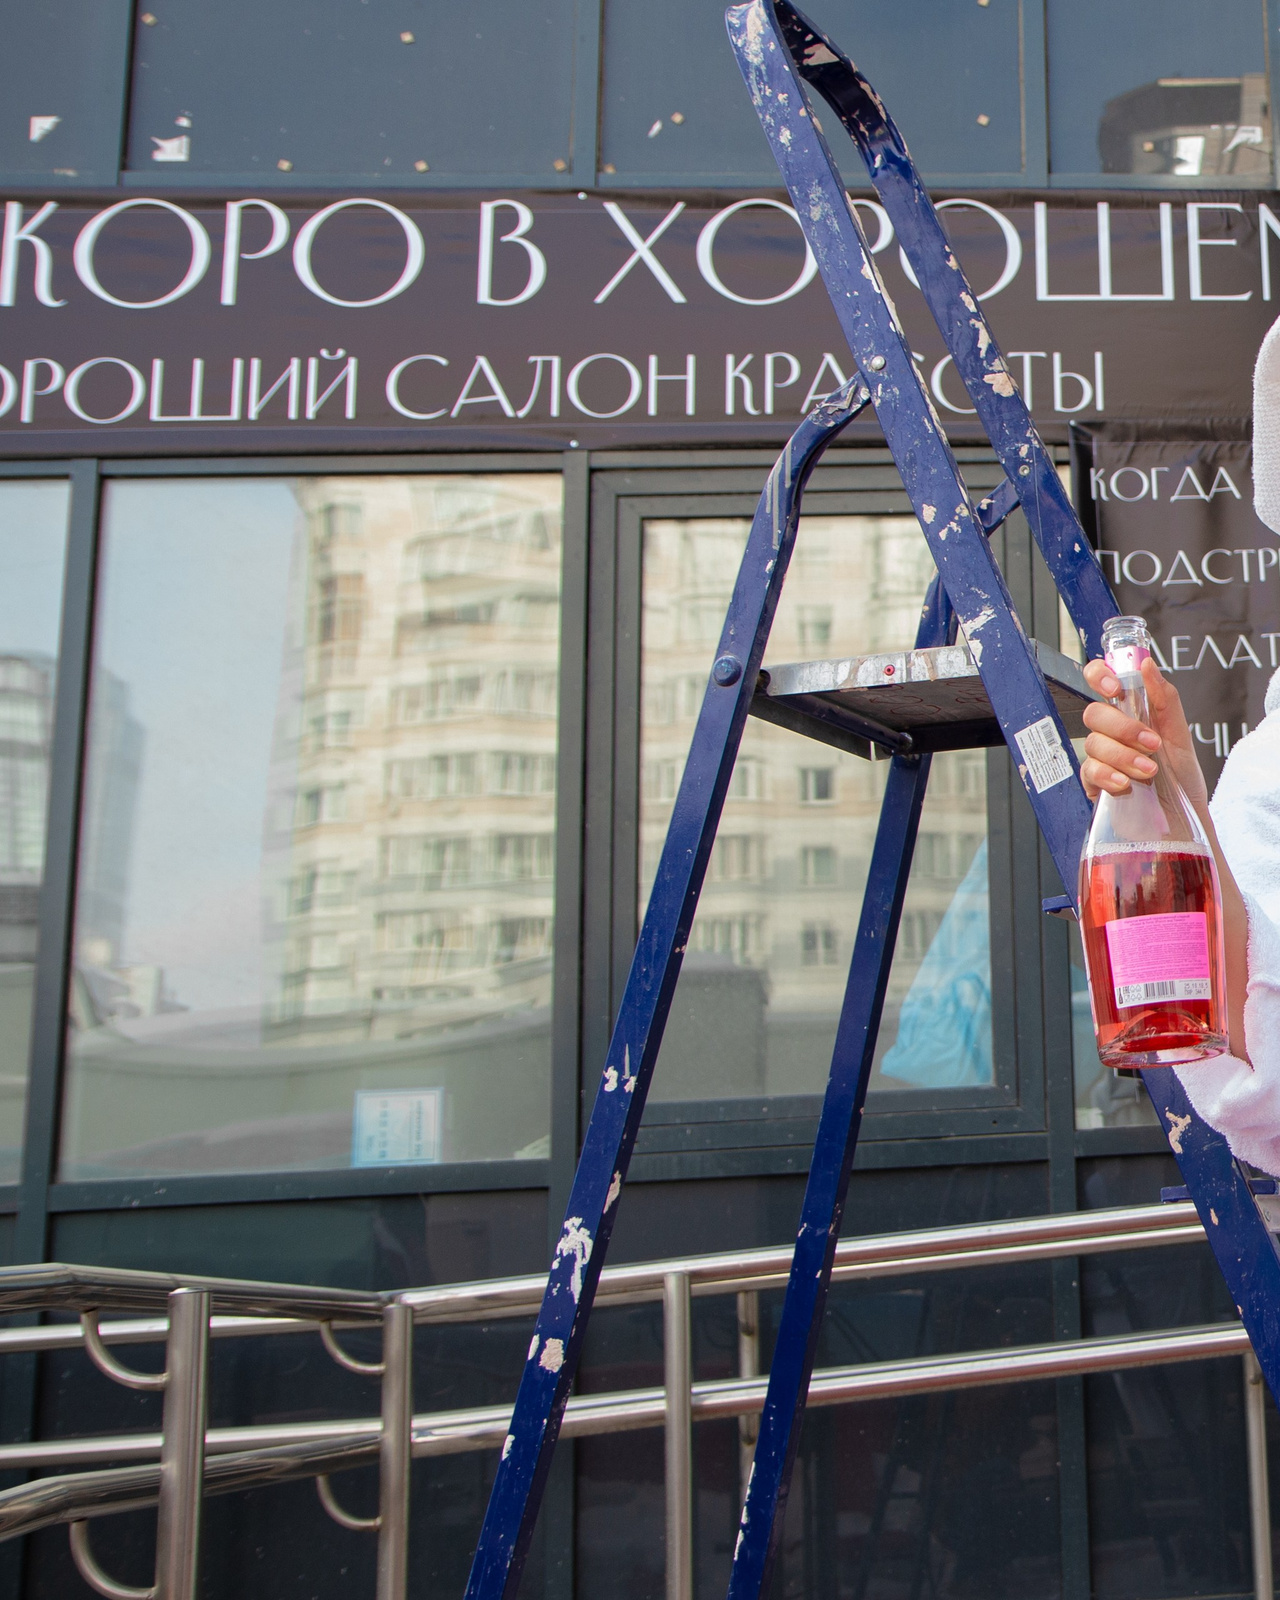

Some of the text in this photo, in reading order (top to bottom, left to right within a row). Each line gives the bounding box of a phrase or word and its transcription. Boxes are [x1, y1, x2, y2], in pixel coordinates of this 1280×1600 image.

[0, 198, 425, 309] КОРО
[477, 199, 547, 306] В
[0, 347, 1104, 424] РОШИЙ САЛОН КРАТЫ
[1089, 466, 1243, 503] КОГДА
